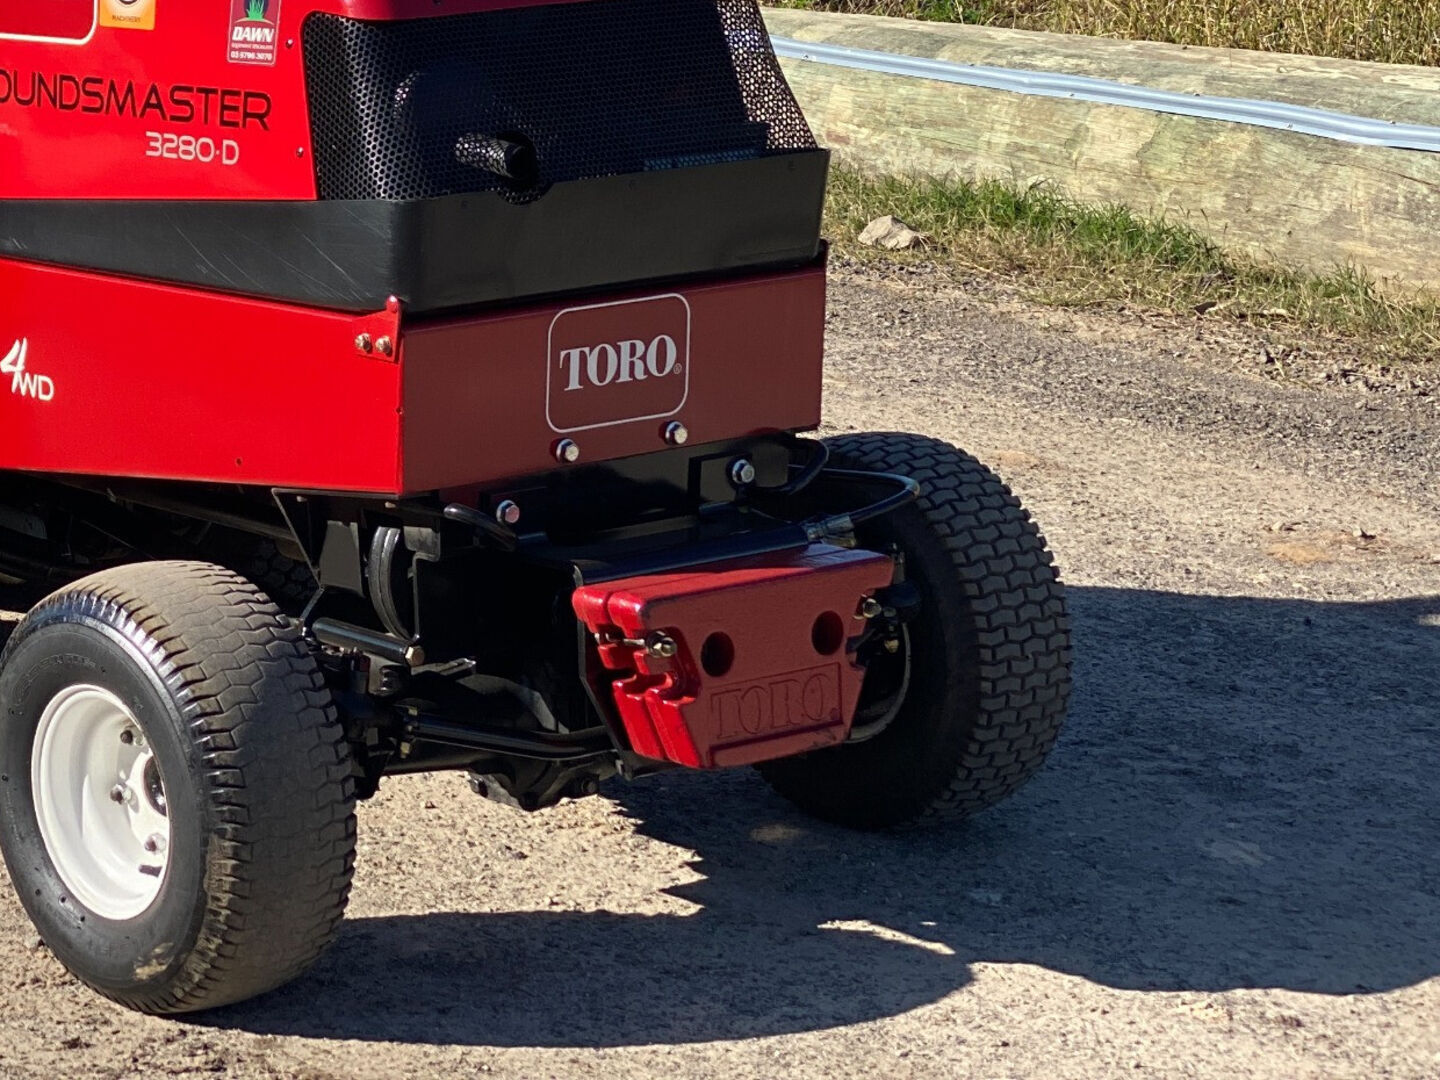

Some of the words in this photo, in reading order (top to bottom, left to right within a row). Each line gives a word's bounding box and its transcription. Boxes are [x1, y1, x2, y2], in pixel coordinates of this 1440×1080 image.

[232, 26, 275, 42] DAWN
[559, 334, 677, 391] TORO
[710, 673, 831, 739] TORO
